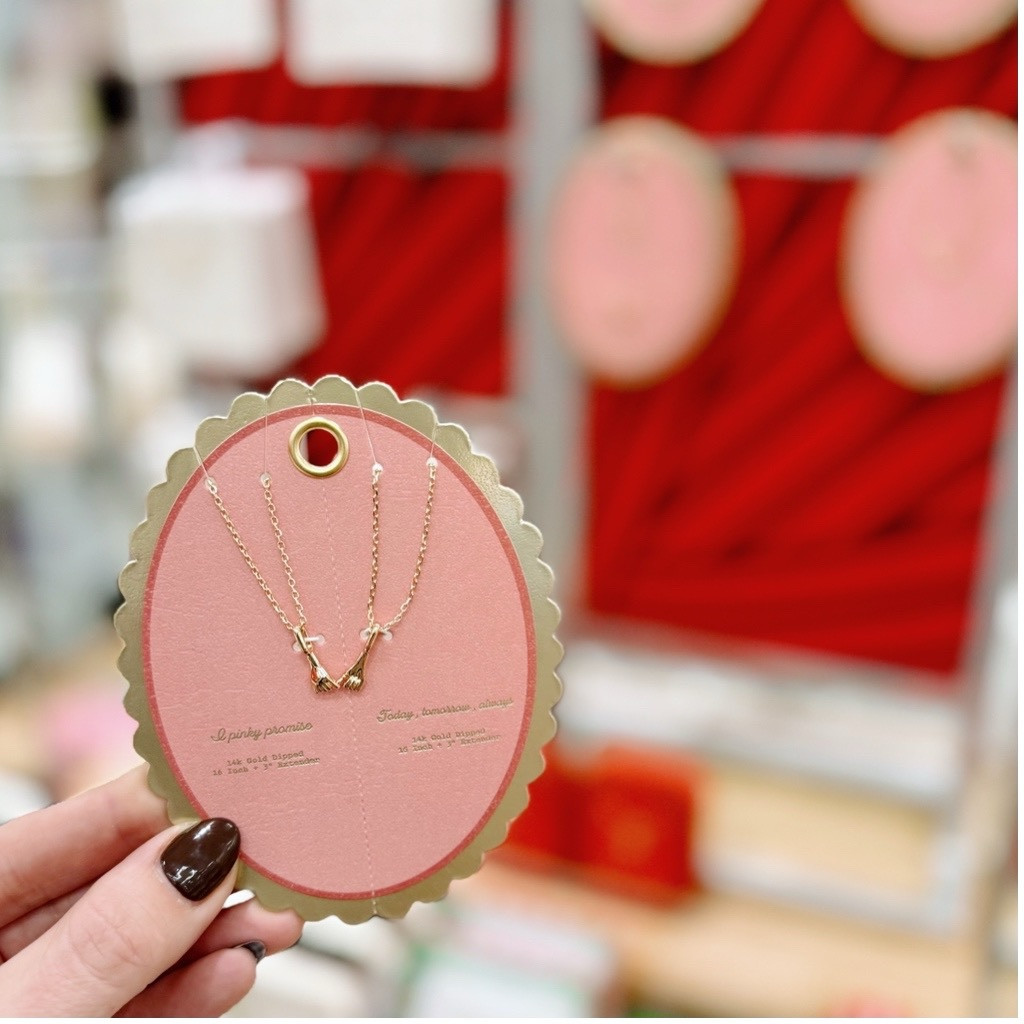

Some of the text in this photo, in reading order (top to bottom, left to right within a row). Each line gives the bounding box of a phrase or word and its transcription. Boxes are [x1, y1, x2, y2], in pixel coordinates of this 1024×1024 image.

[377, 708, 418, 722] Today,
[478, 697, 514, 710] always
[210, 721, 313, 743] I pinky promise
[455, 727, 486, 738] Dipped
[412, 743, 433, 752] Inch
[460, 734, 503, 745] Extender
[227, 766, 249, 775] Inch
[276, 757, 320, 769] Extender
[246, 756, 268, 764] Gold
[271, 750, 304, 761] Dipped
